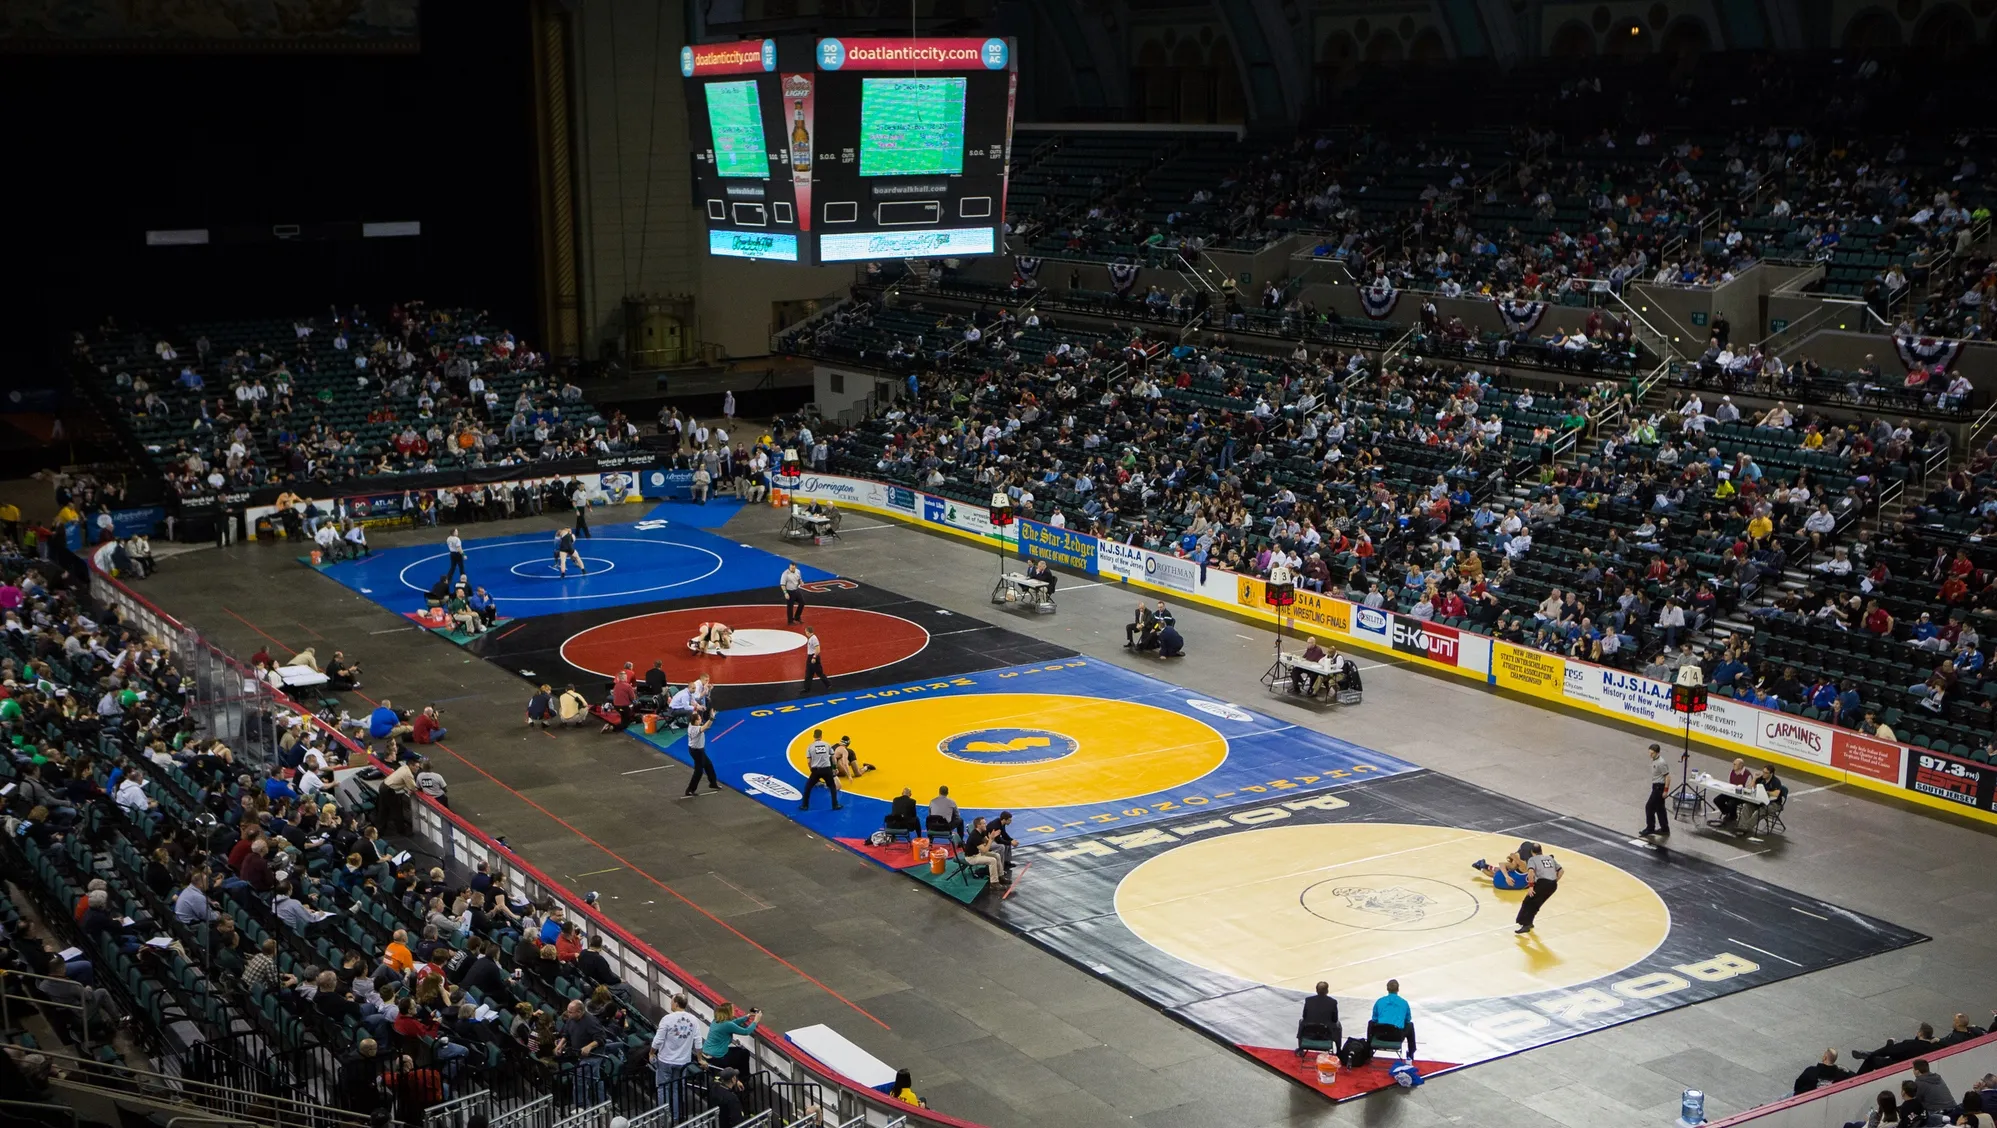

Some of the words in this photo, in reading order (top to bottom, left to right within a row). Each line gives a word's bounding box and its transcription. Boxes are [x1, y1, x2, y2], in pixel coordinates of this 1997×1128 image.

[695, 50, 761, 66] doatlanticcity.com
[824, 56, 837, 64] AC
[849, 46, 978, 61] doatlanticcity.com
[873, 186, 946, 194] boardwalkhall.com
[805, 477, 854, 495] Dorrington
[1022, 522, 1039, 541] The
[1040, 527, 1095, 557] Star-Ledger
[1029, 544, 1039, 556] THE
[1099, 554, 1114, 564] History
[1130, 560, 1144, 571] Jersey
[1112, 564, 1131, 577] Wrestling
[1156, 563, 1195, 579] ROTHMAN
[1281, 571, 1287, 581] 3
[1293, 607, 1325, 624] WRESTLING
[1326, 615, 1347, 630] FINALS
[1500, 653, 1515, 663] STATE
[1514, 656, 1555, 673] INTERSCHOLASTIC
[1513, 648, 1524, 657] NEW
[1525, 650, 1542, 661] JERSEY
[998, 660, 1087, 680] 2013
[1502, 661, 1523, 673] ATHLETIC
[1523, 667, 1552, 681] ASSOCIATION
[1510, 671, 1542, 686] CHAMPIONSHIP
[1564, 667, 1584, 681] ress
[1681, 671, 1688, 680] 4
[1692, 671, 1698, 682] 4
[750, 676, 977, 718] WRESTLING
[1602, 686, 1626, 702] History
[1628, 693, 1636, 701] of
[1641, 695, 1653, 706] New
[1623, 702, 1655, 719] Wrestling
[1706, 704, 1725, 714] AVERN
[1689, 720, 1700, 728] AVE
[1702, 713, 1714, 721] THE
[1715, 716, 1737, 727] EVENT!
[1766, 722, 1822, 752] CARMINE'S
[1919, 755, 1965, 777] 97.3
[1965, 771, 1975, 779] FM
[1916, 766, 1978, 797] ESPN
[1026, 764, 1378, 835] CHAMPIONSHIP
[1916, 782, 1944, 795] SOUTH
[1946, 789, 1975, 804] JERSEY
[1046, 794, 1350, 861] POINT
[1468, 952, 1760, 1037] BORO
